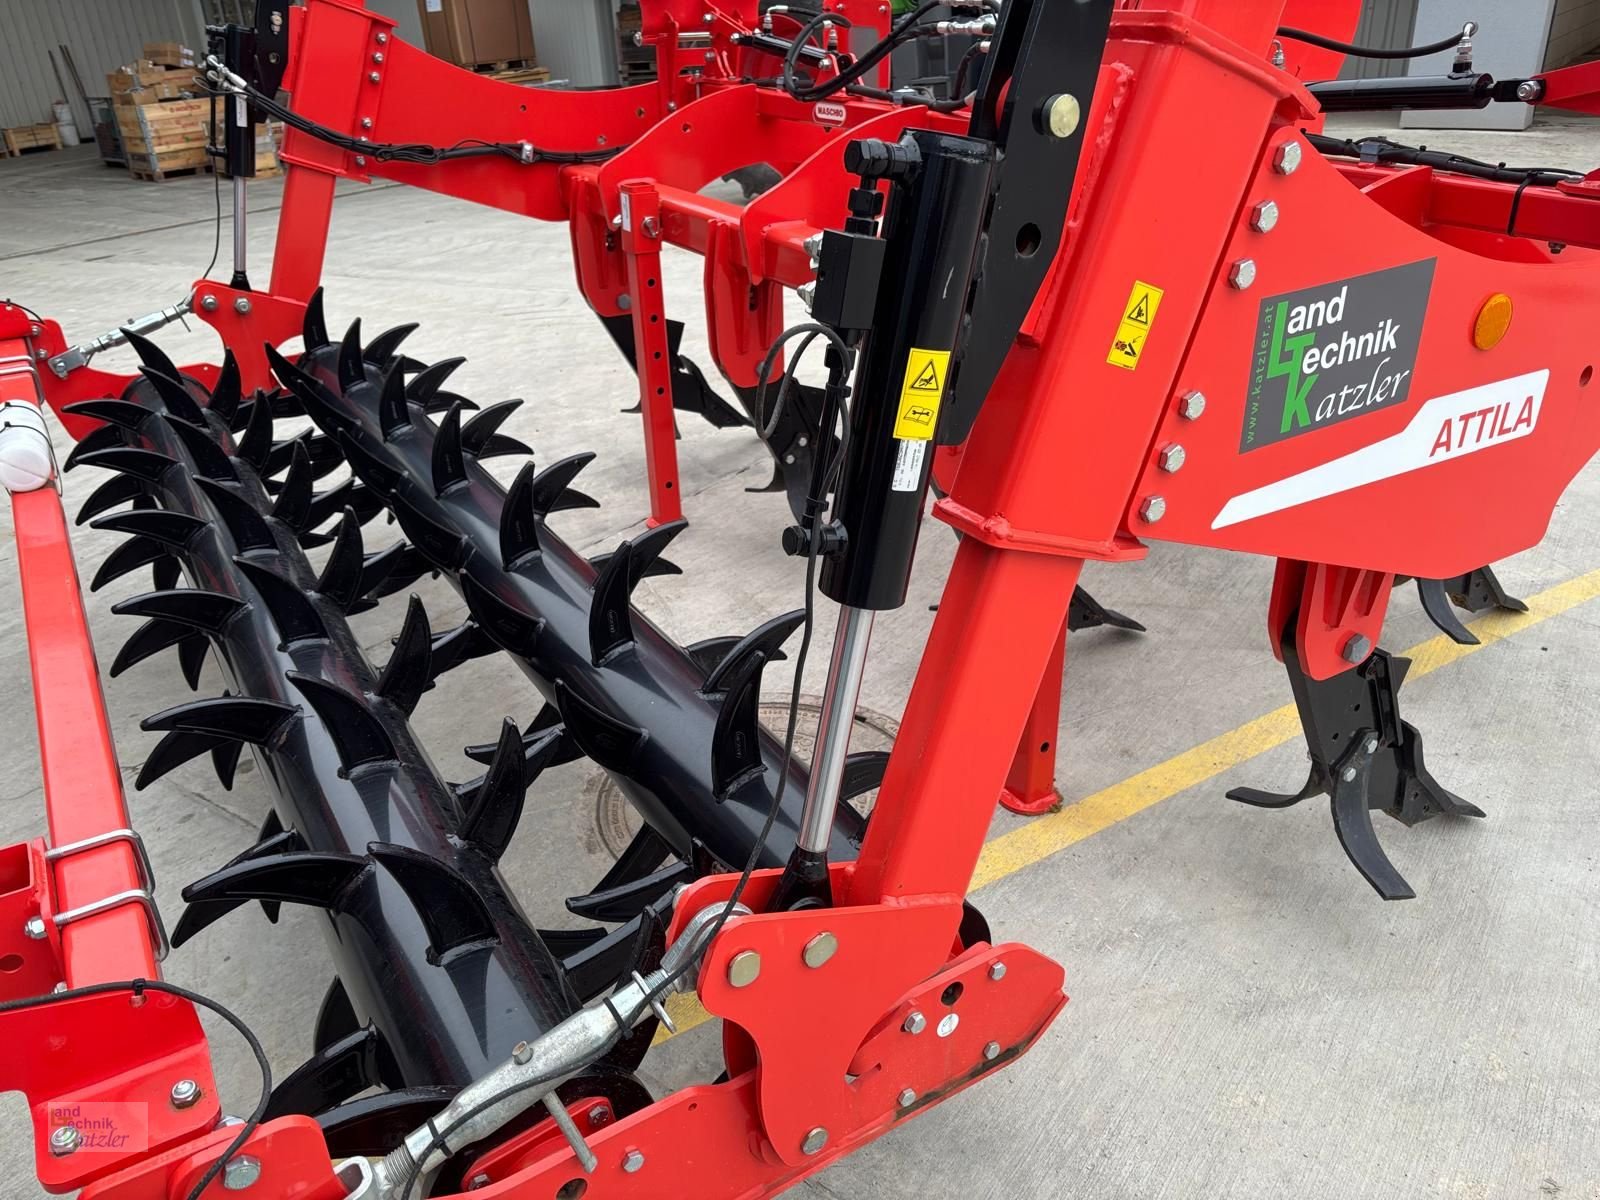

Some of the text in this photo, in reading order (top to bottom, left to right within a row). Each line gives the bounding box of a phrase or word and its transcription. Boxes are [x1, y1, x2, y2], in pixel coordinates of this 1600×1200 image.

[1267, 285, 1348, 379] Land
[1285, 318, 1401, 382] Technik
[1247, 304, 1274, 444] www.katzler.at
[1280, 356, 1410, 434] Katzler
[1428, 395, 1534, 458] ATTILA
